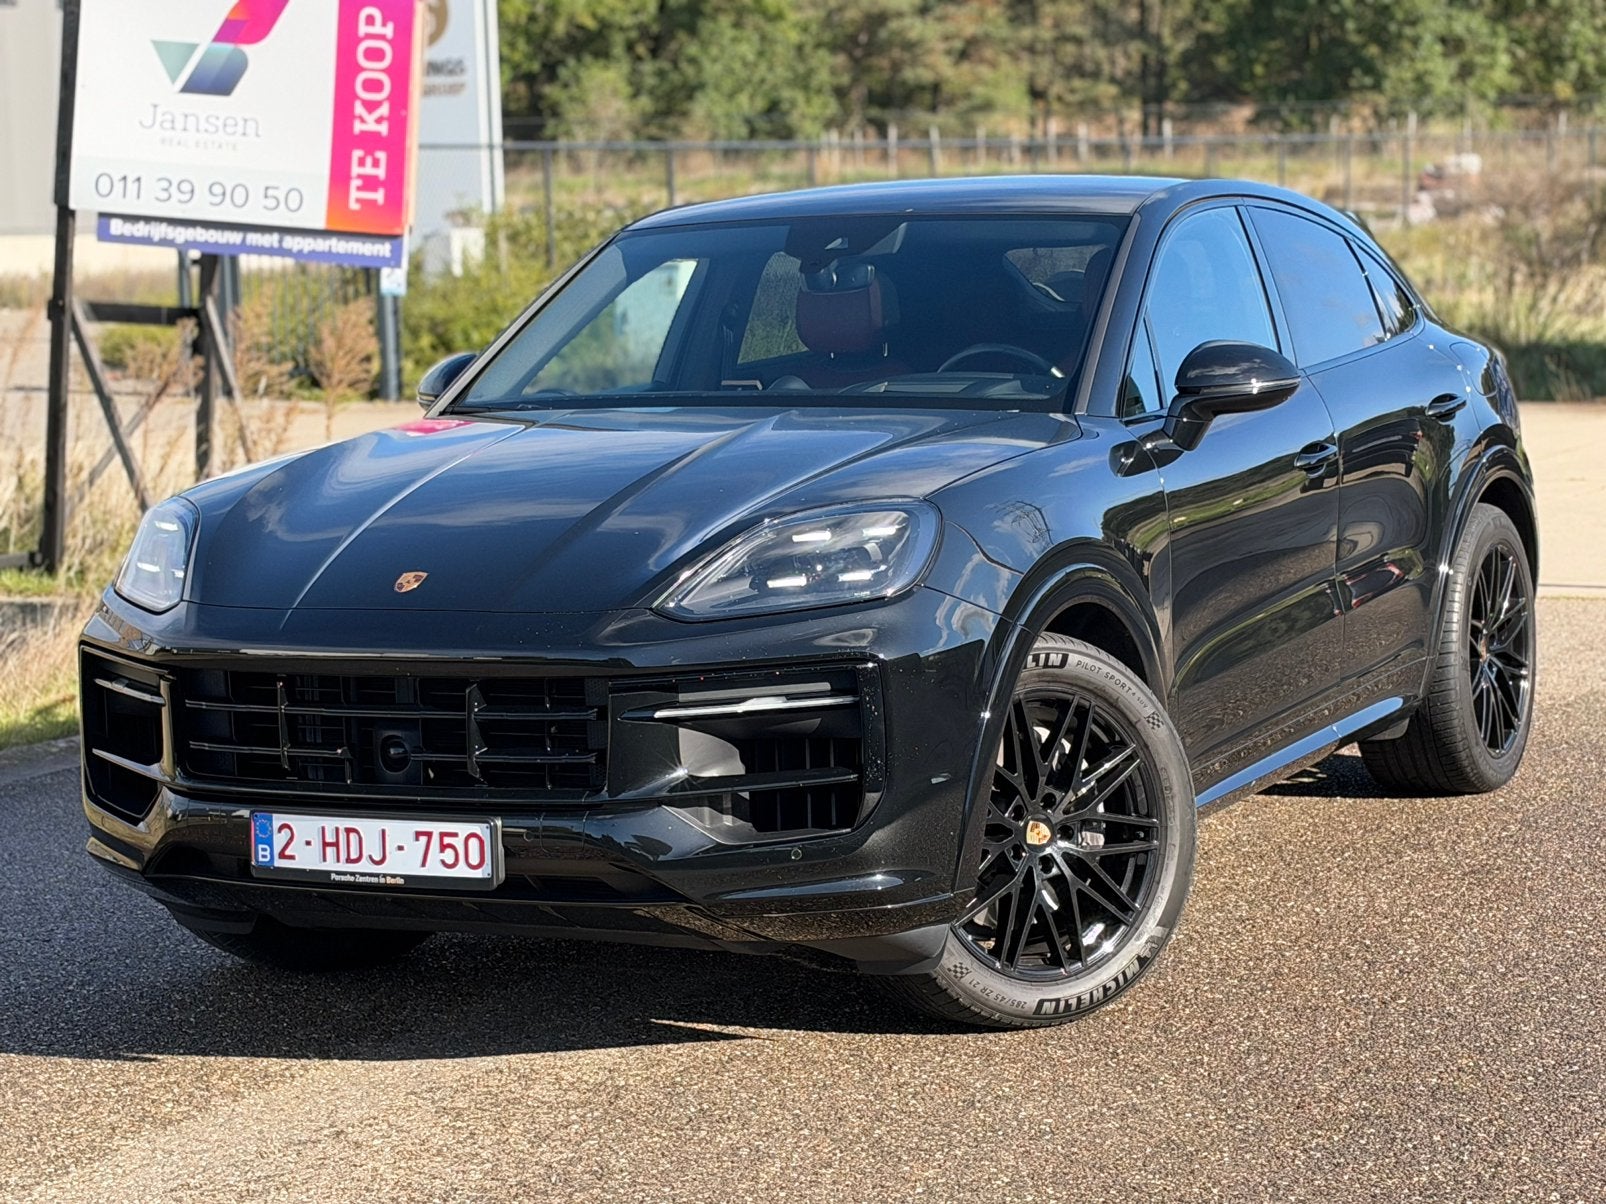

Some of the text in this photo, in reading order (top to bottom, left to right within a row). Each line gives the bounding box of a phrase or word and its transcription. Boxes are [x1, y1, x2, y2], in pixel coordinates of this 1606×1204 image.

[138, 103, 261, 138] Jansen
[348, 6, 394, 211] TE KOOP
[95, 172, 304, 213] 011 39 90 50
[109, 217, 391, 258] Bedrijfsgebouw met appartement
[1103, 671, 1133, 694] SPORT
[257, 844, 271, 862] B
[277, 822, 486, 871] 2-HDJ-750
[330, 872, 355, 882] Porsche
[355, 873, 379, 884] Zentren
[386, 875, 405, 885] Berlin
[1040, 957, 1141, 1015] MICHELIN
